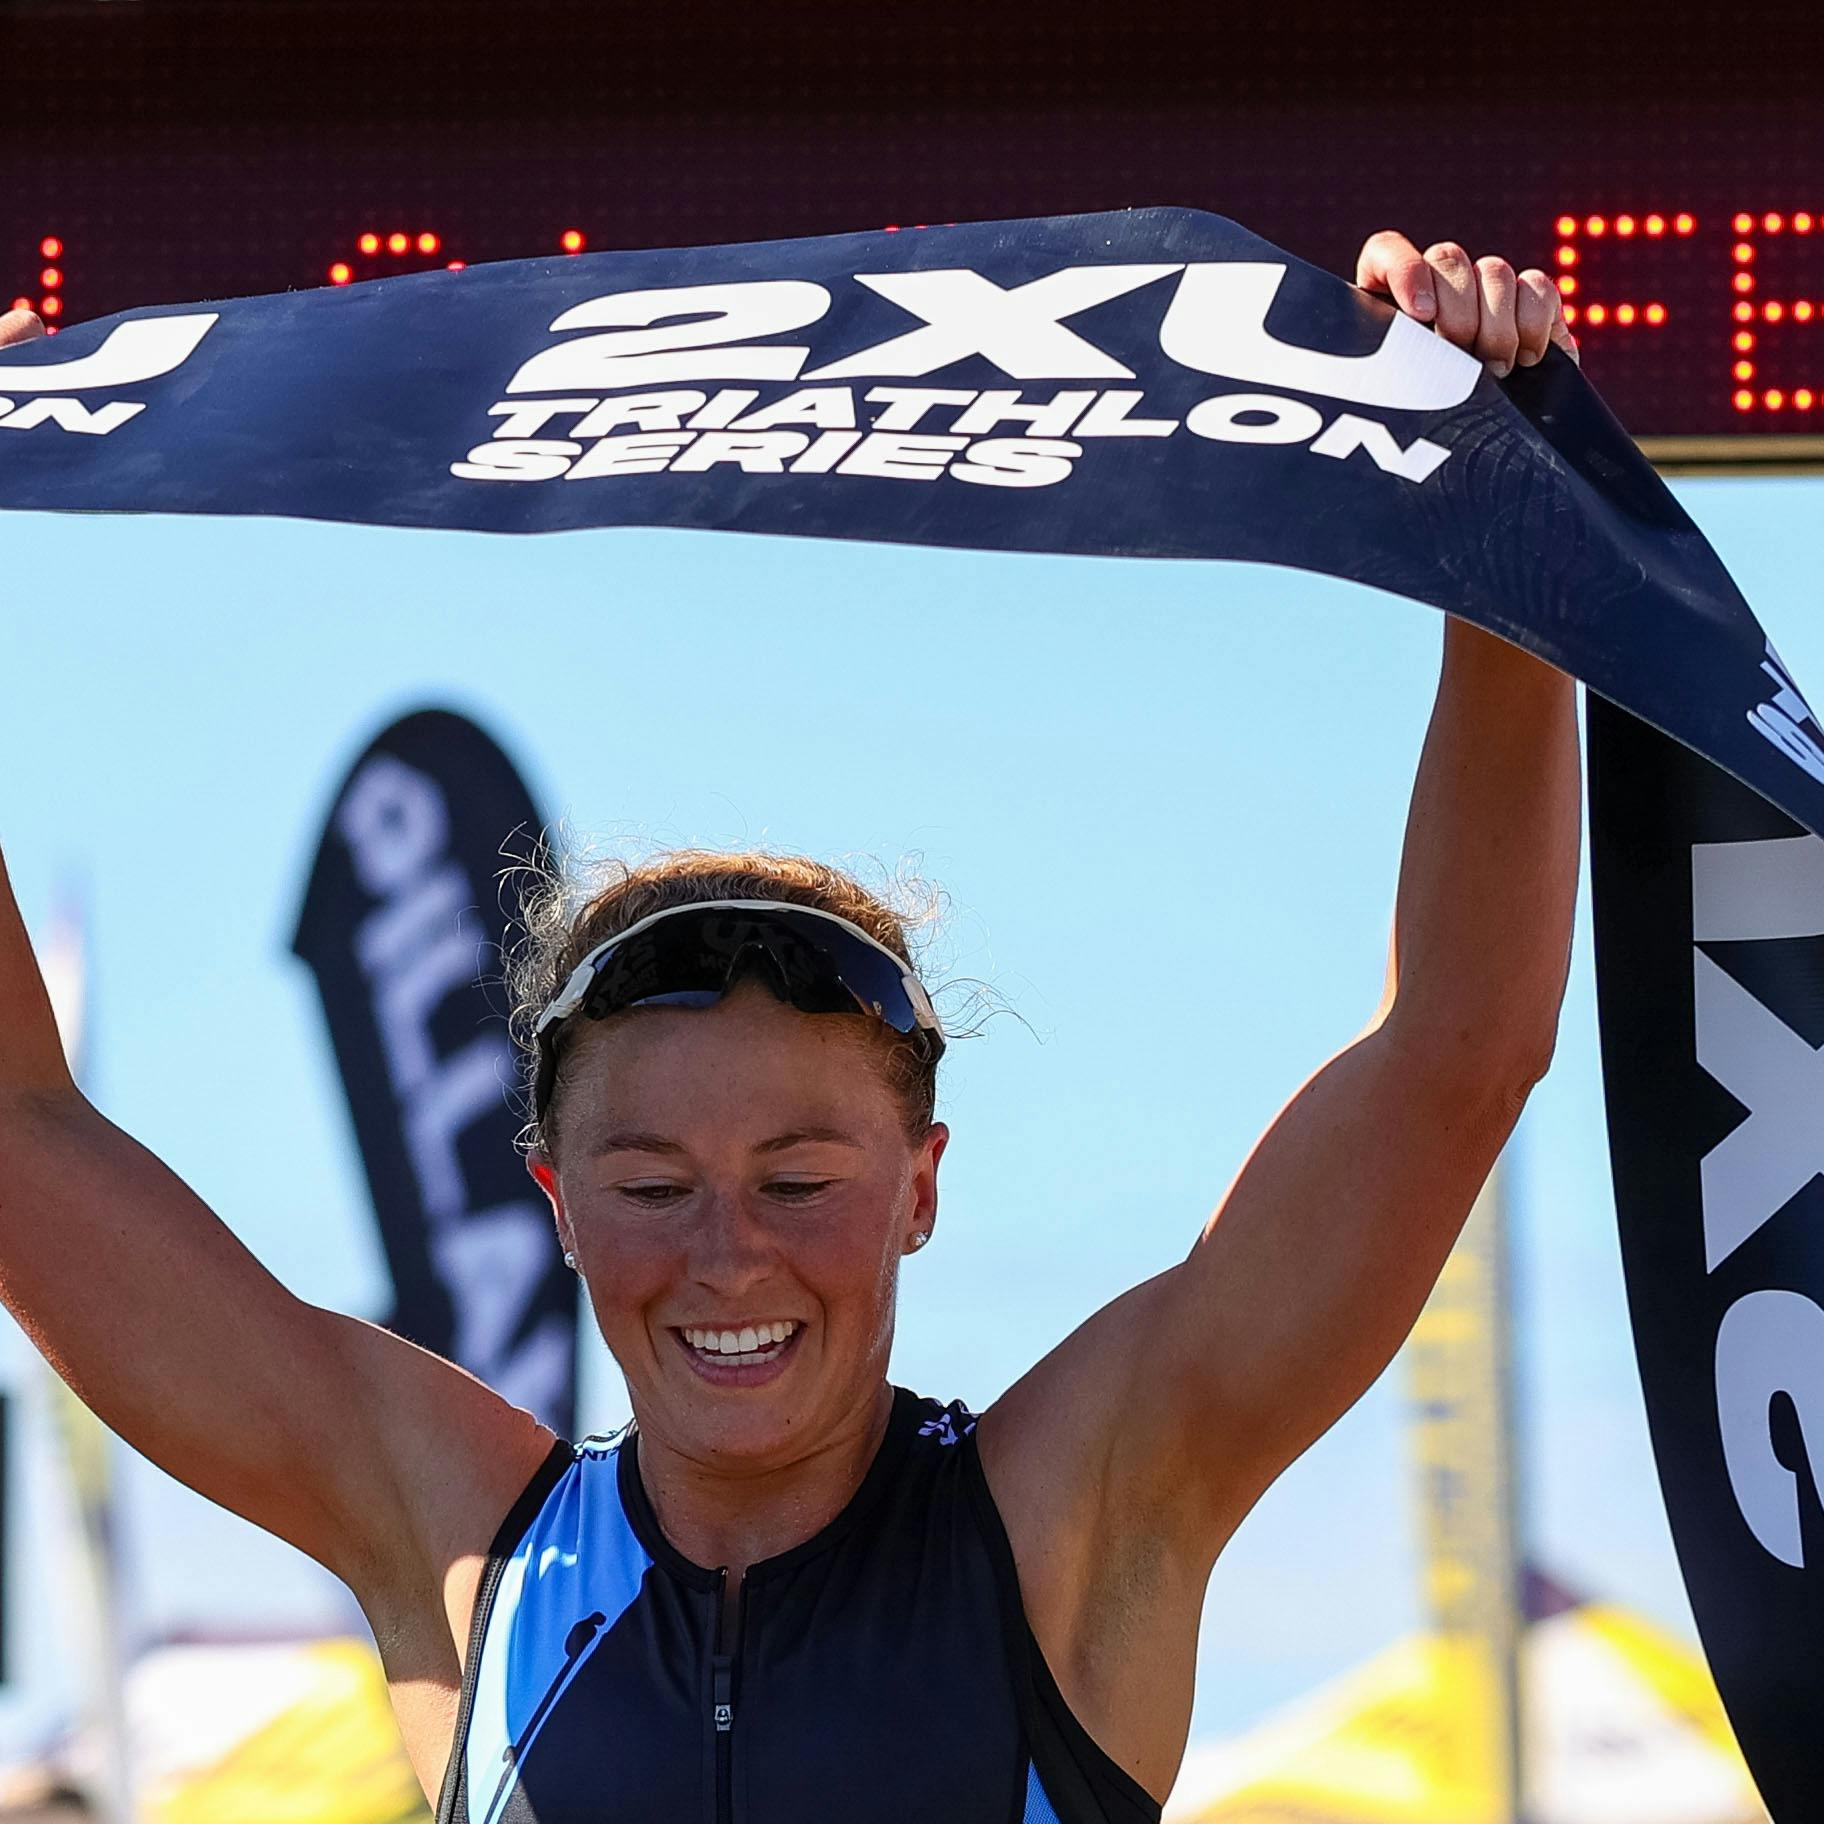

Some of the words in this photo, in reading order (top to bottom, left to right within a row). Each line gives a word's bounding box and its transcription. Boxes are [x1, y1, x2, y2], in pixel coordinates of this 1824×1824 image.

[507, 262, 1484, 411] 2XU
[449, 429, 1084, 487] SERIES
[486, 385, 1453, 484] TRIATHLON
